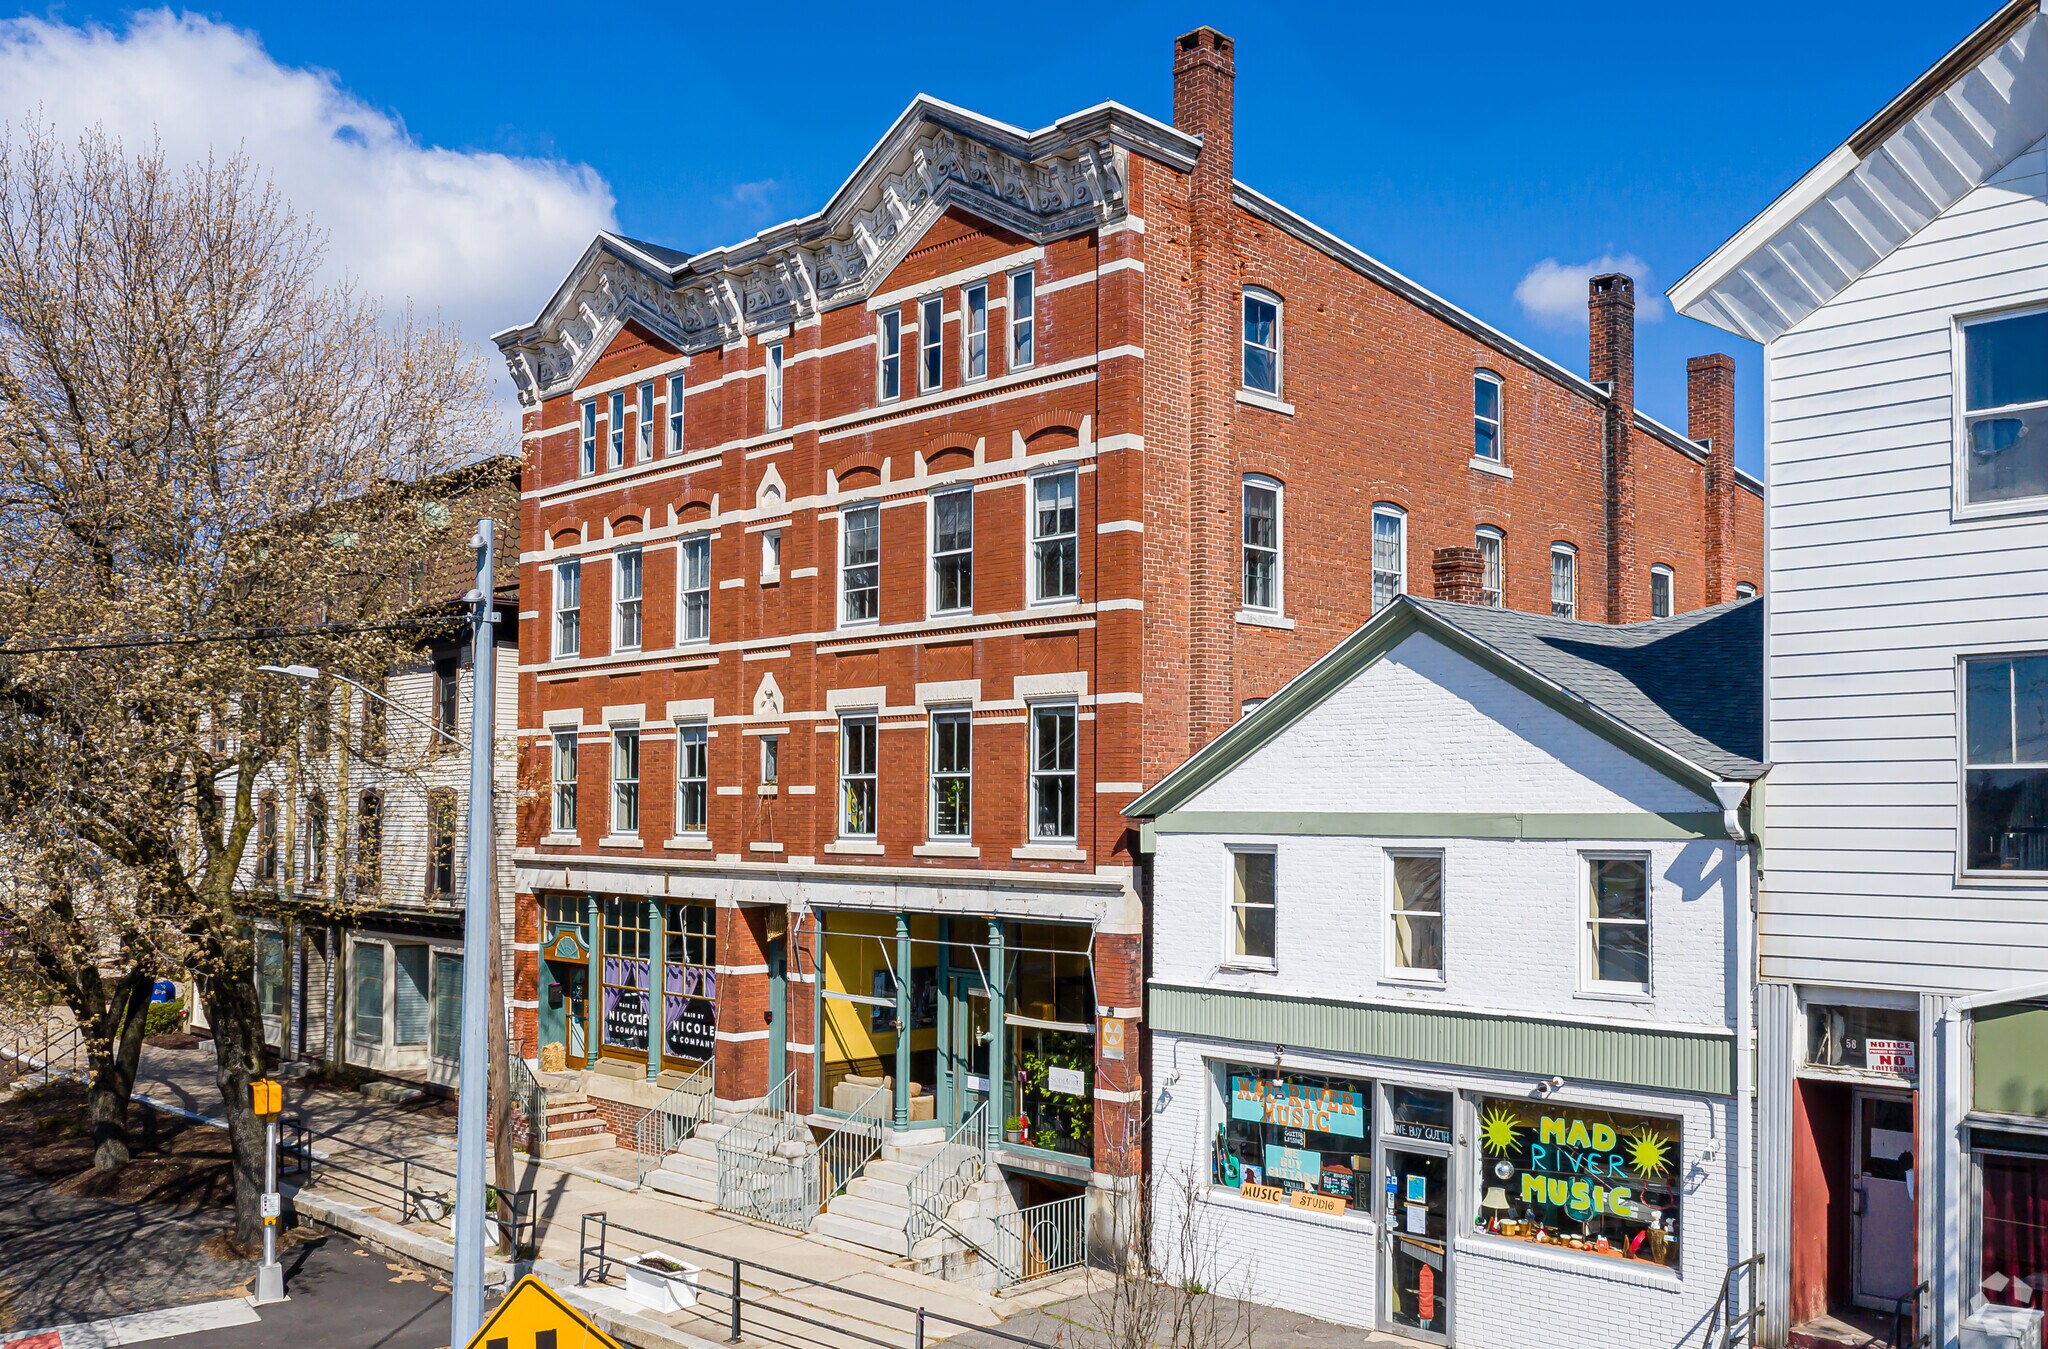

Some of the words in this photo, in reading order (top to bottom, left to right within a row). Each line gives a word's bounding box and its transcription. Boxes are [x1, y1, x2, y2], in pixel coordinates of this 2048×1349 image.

[609, 1010, 648, 1026] NICOLE
[683, 1011, 696, 1019] HAIR
[608, 1024, 613, 1032] &
[615, 1026, 648, 1037] COMPANY
[673, 1020, 715, 1037] NICOLE
[679, 1036, 715, 1049] COMPANY
[1845, 1038, 1857, 1049] 58
[1870, 1041, 1911, 1049] NOTICE
[1879, 1055, 1906, 1066] NO
[1871, 1065, 1914, 1073] LOITERING
[1237, 1078, 1280, 1103] MAD
[1288, 1084, 1356, 1115] RIVER
[1262, 1101, 1331, 1132] MUSIC
[1394, 1123, 1408, 1135] WE
[1408, 1125, 1422, 1139] BUY
[1539, 1115, 1617, 1153] MAD
[1284, 1149, 1299, 1160] WE
[1531, 1143, 1628, 1179] RIVER
[1280, 1156, 1303, 1171] BUY
[1242, 1186, 1281, 1202] MUSIC
[1358, 1174, 1367, 1209] OPEN
[1521, 1172, 1632, 1217] MUSIC
[1299, 1195, 1335, 1211] STUDIO
